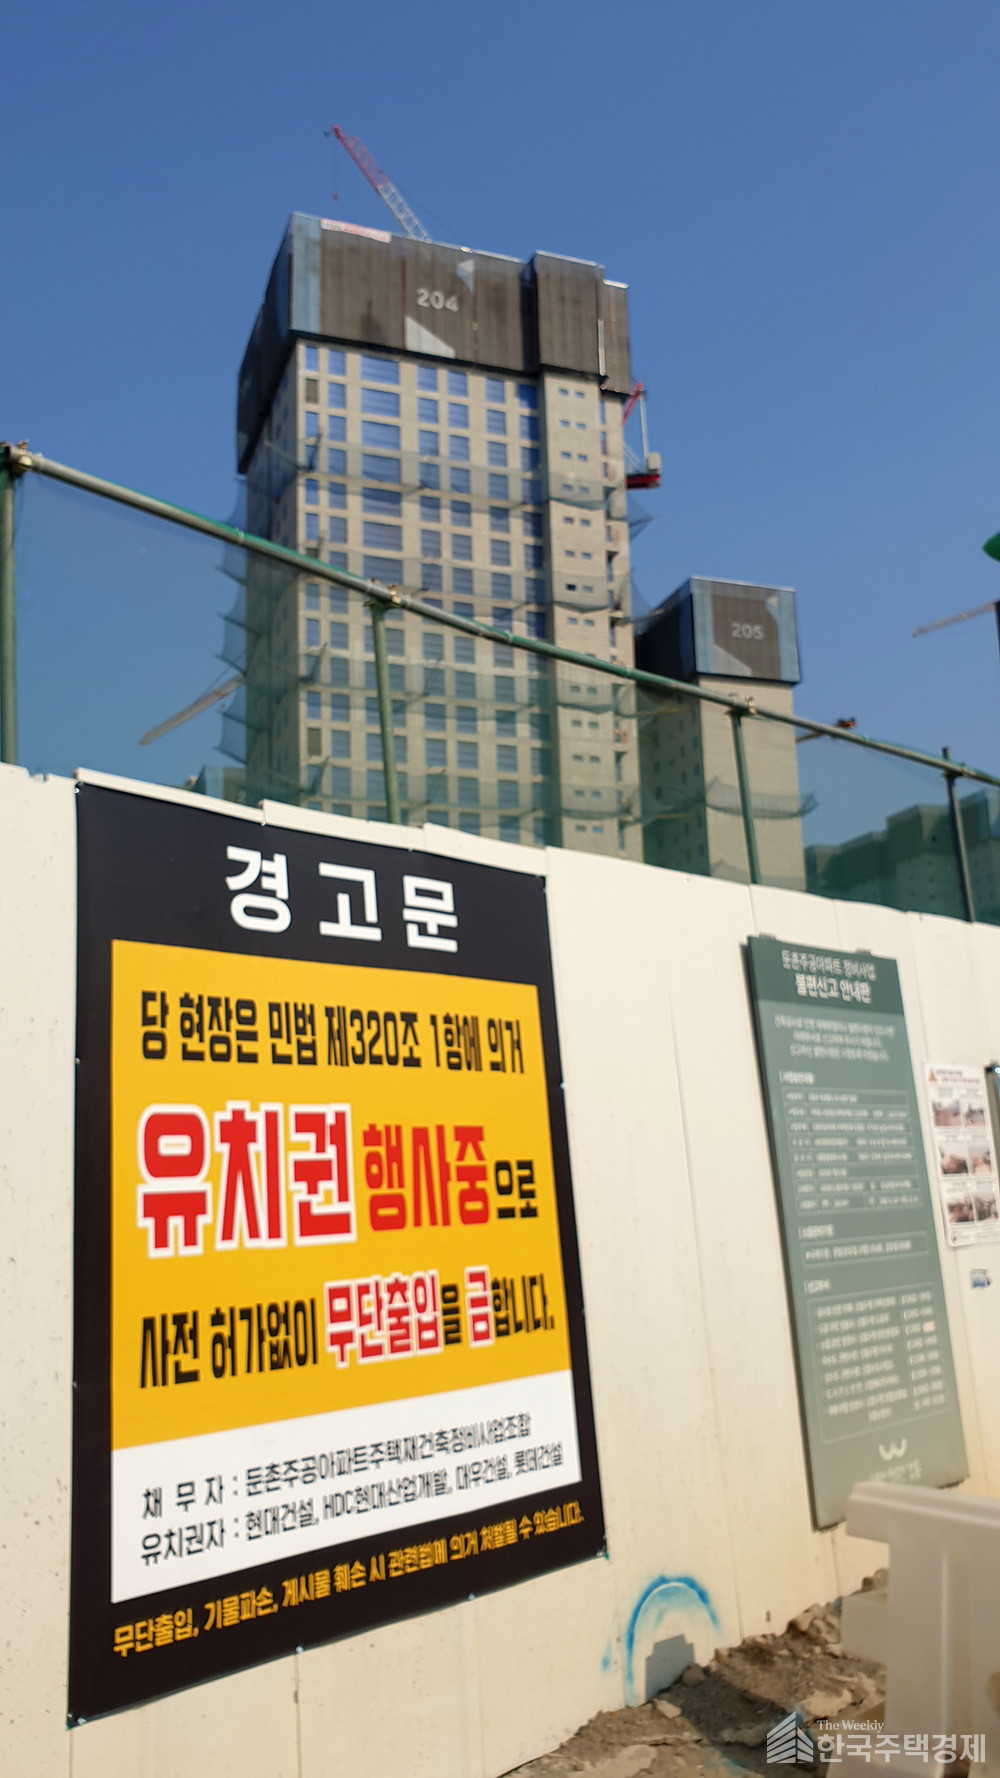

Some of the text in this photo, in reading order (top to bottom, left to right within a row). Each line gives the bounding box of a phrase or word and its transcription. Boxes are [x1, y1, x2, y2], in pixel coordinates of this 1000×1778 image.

[416, 286, 460, 312] 204
[731, 622, 765, 641] 205
[225, 845, 458, 952] 경고문
[141, 990, 525, 1075] 당 현장은 민법 제320조 1항에 의거
[136, 1100, 538, 1259] 유치권 행사중으로
[140, 1264, 555, 1388] 사전 허가없이 무단출입을 금합니다.
[141, 1518, 226, 1567] 유치권자
[245, 1498, 320, 1541] 현대건설,
[455, 1454, 512, 1491] 대우건설,
[113, 1607, 200, 1658] 무단출입,
[203, 1585, 279, 1631] 기물파손,
[281, 1568, 332, 1608] 게시물
[333, 1560, 367, 1593] 훼손
[369, 1553, 386, 1582] 시
[450, 1528, 479, 1561] 의거
[519, 1515, 534, 1540] 수
[533, 1500, 585, 1536] 있습니다.
